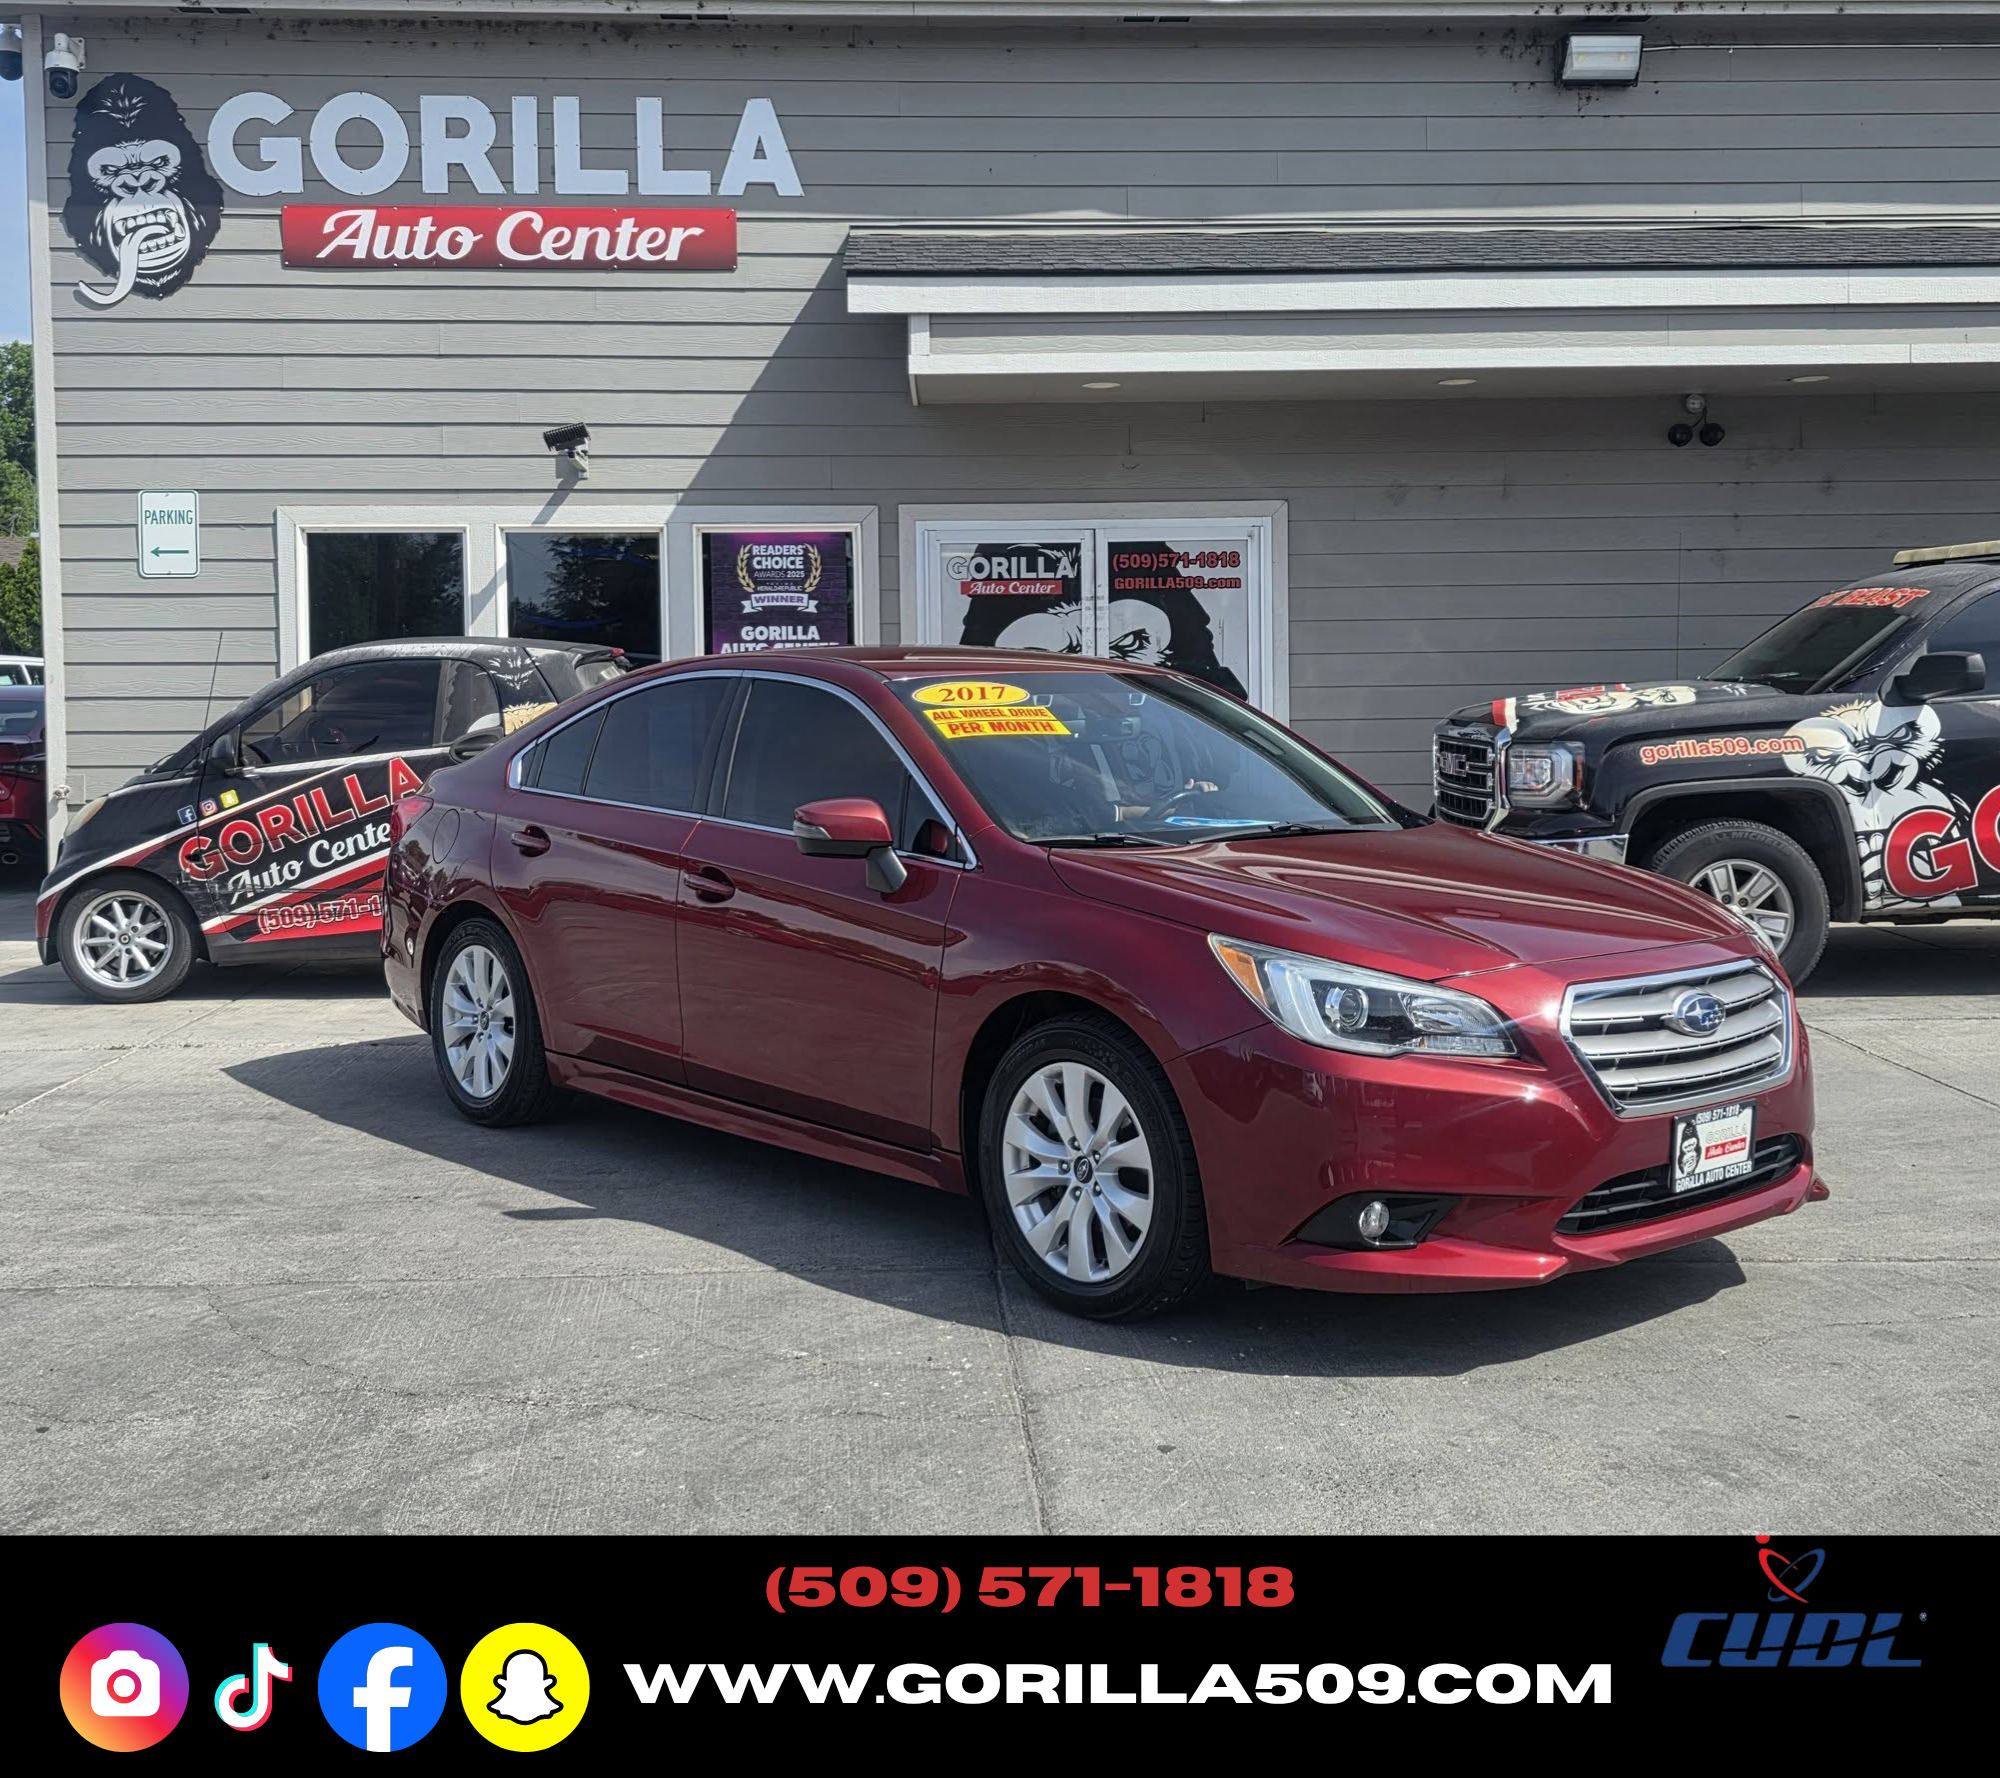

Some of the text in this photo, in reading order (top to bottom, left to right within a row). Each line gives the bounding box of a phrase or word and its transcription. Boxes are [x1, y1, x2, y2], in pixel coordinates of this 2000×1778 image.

[208, 91, 805, 196] GORILLA
[316, 209, 704, 262] Auto Center
[144, 510, 193, 525] PARKING
[752, 557, 804, 569] CHOICE
[946, 556, 1077, 581] GORILLA
[1112, 551, 1240, 571] (509)571-1818
[969, 581, 1056, 595] Auto Center
[1114, 576, 1241, 590] GORILLA509.com
[753, 595, 805, 604] WINNER
[741, 626, 820, 641] GORILLA
[938, 686, 1006, 703] 2017
[933, 708, 1048, 721] ALL WHEEL DRIVE
[947, 721, 1054, 735] PER MONTH
[1640, 735, 1805, 765] gorilla509.com
[178, 756, 424, 881] GORILLA
[226, 859, 305, 905] Auto
[257, 894, 383, 935] (509) 571-1
[1706, 1123, 1747, 1144] GORILLA
[1676, 1160, 1752, 1193] GORILLA AUTO CENTER
